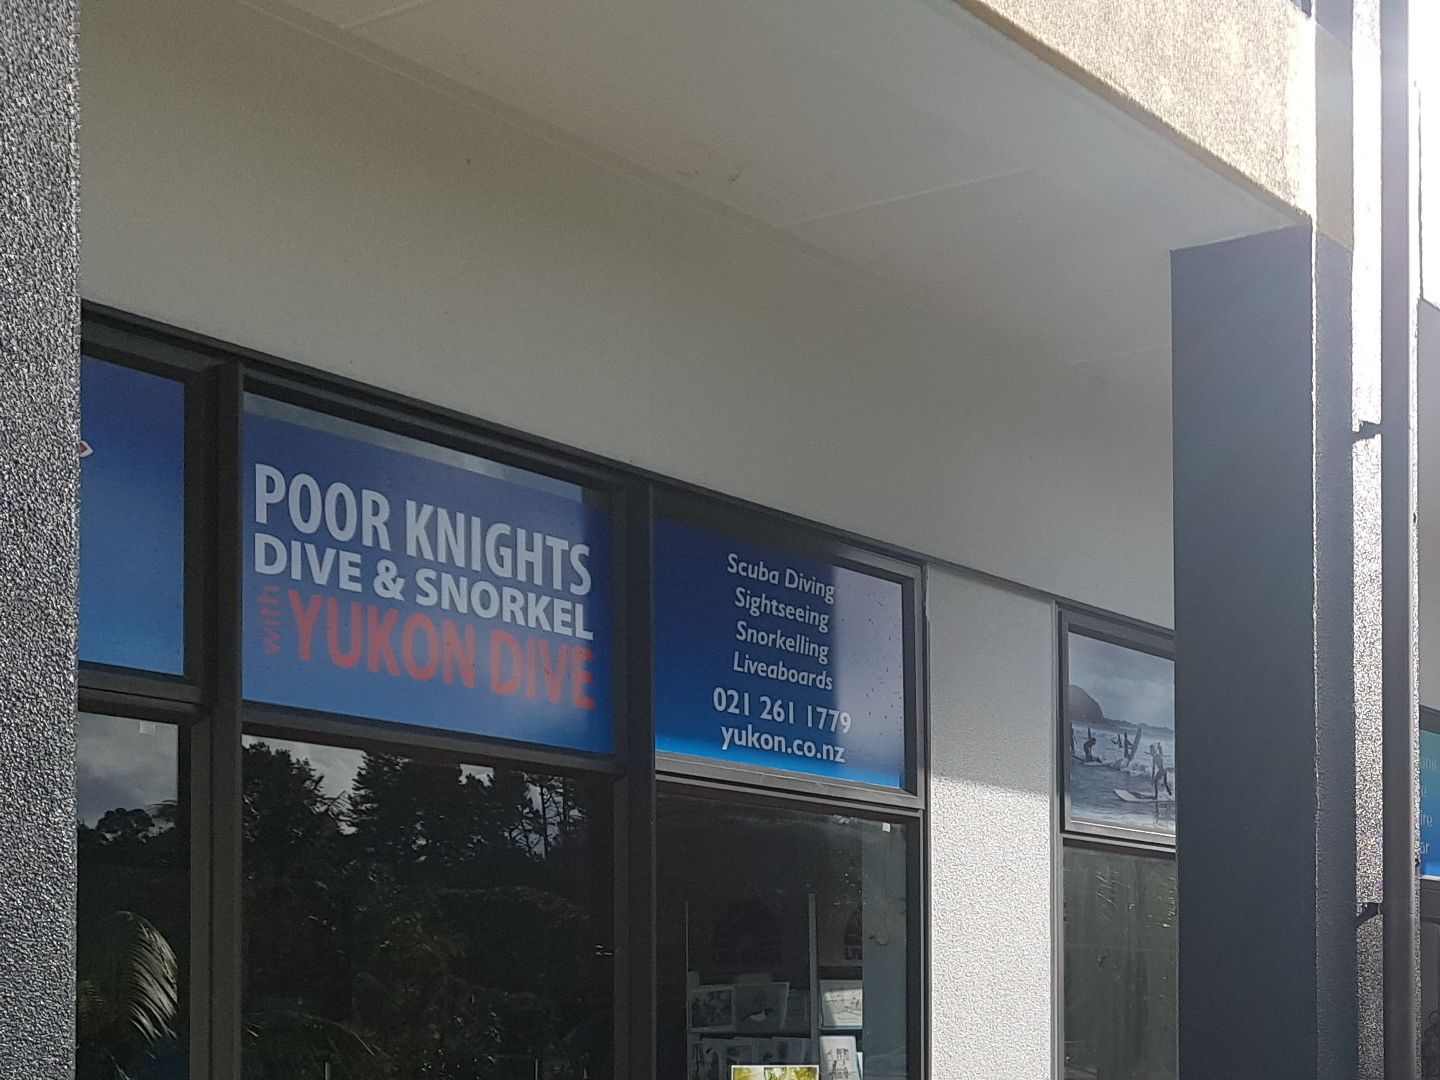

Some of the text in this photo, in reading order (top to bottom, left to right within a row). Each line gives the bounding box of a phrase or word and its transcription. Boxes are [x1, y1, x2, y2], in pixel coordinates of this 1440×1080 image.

[255, 463, 593, 596] POOR KNIGHTS
[254, 533, 594, 640] DIVE & SNORKEL
[727, 553, 836, 605] Scuba Diving
[257, 583, 282, 655] with
[735, 587, 830, 633] Sightseeing
[288, 588, 597, 710] YUKON DIVE
[736, 620, 830, 665] Snorkelling
[733, 651, 833, 691] Liveaboards
[713, 687, 852, 734] 021 261 1779
[721, 724, 846, 763] yukon.co.nz
